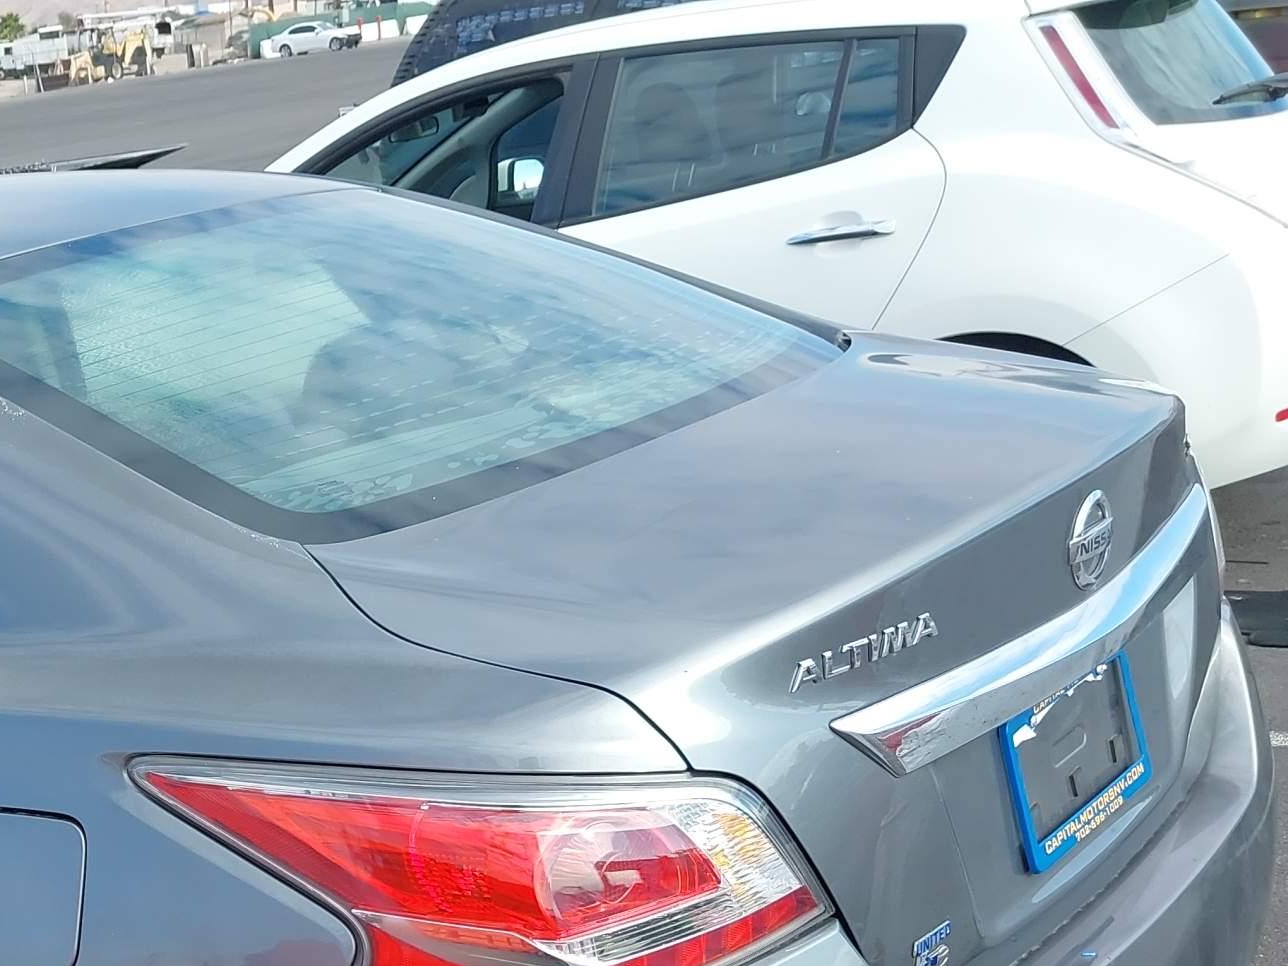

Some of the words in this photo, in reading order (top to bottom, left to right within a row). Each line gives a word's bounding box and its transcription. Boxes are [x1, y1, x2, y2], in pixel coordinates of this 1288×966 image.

[1079, 528, 1112, 556] NISS
[789, 611, 940, 693] ALTIMA
[1045, 761, 1145, 855] CAPITALMOTORSNV.COM
[917, 925, 951, 956] UNITED
